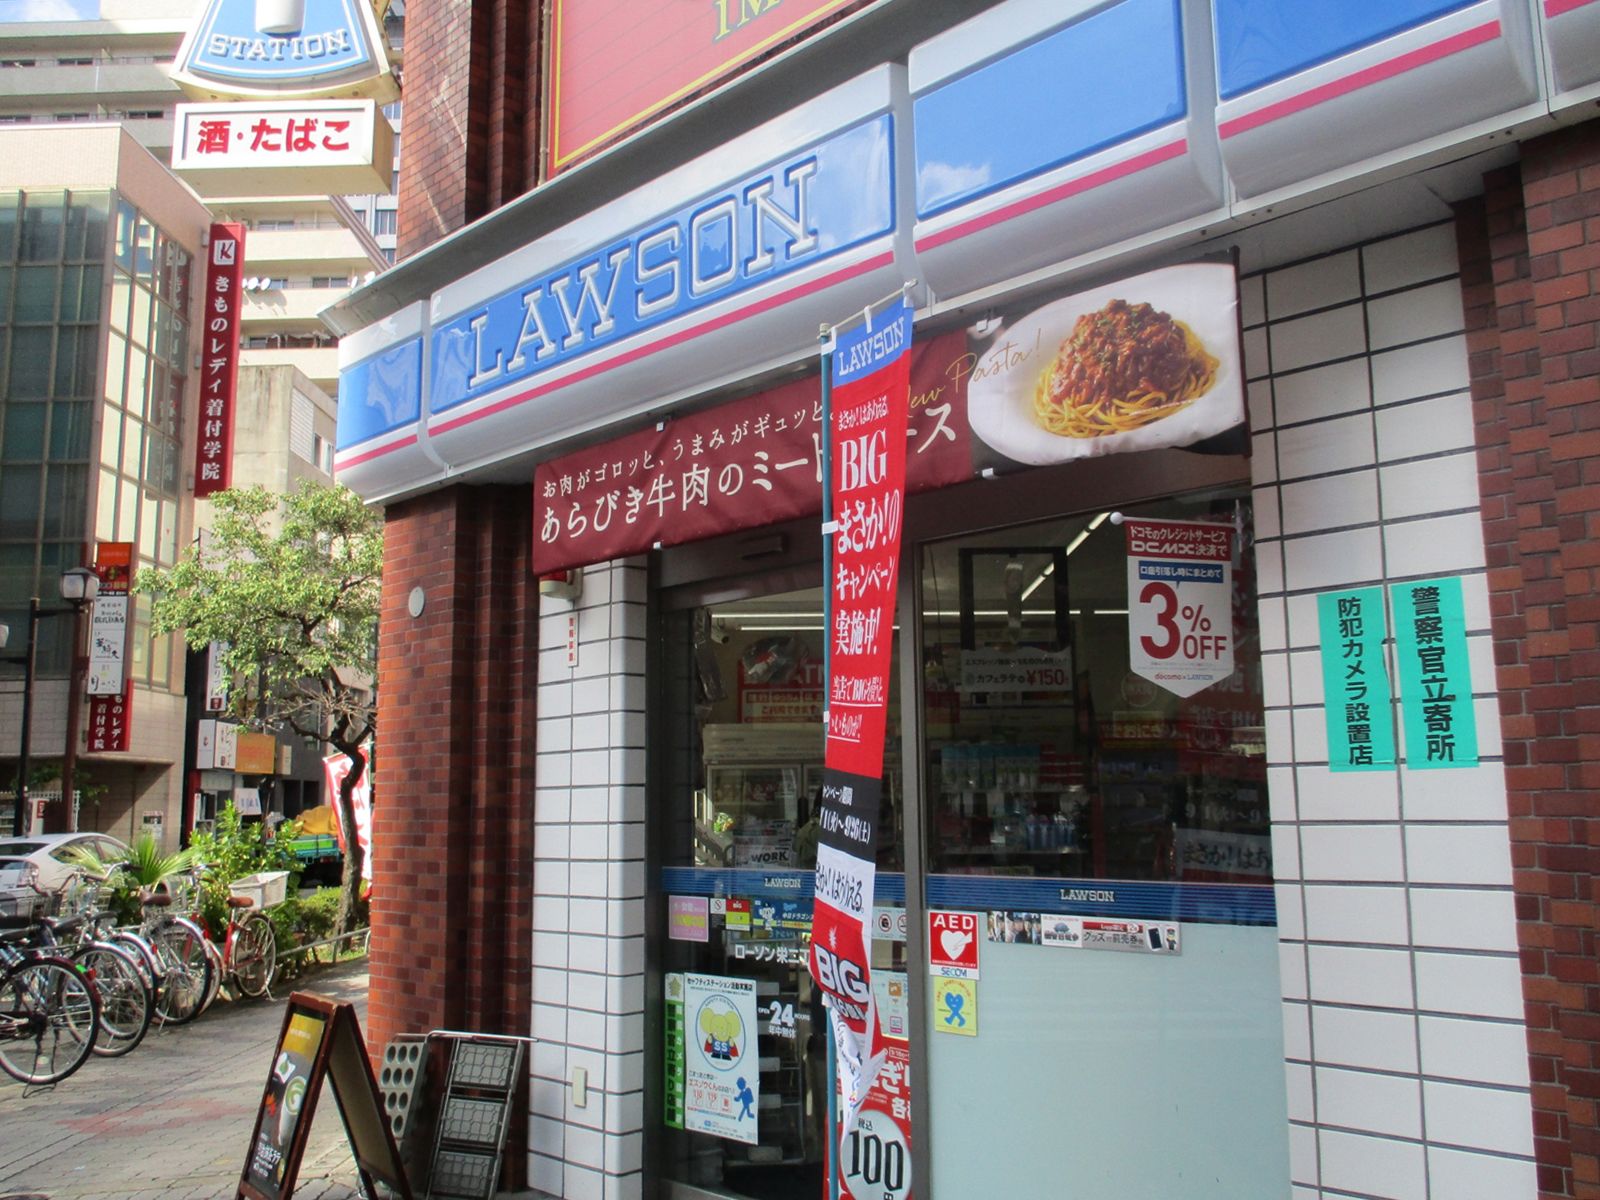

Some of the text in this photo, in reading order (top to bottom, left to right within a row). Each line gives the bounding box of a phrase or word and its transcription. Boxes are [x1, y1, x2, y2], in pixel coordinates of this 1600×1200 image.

[207, 28, 352, 62] STATION
[197, 118, 351, 154] 酒・たばこ
[468, 155, 821, 390] LAWSON
[839, 316, 905, 376] LAWSON
[946, 328, 1042, 393] Pasta!
[201, 275, 230, 481] きものレディ着付学院
[838, 429, 889, 493] BIG
[1130, 526, 1227, 543] ドコモのクレジットサービス
[835, 606, 881, 656] 実施中!
[1183, 634, 1228, 661] OFF
[1336, 597, 1374, 766] 防犯カメラ設置店
[1411, 585, 1456, 763] 警察官立寄所
[764, 877, 801, 888] LAWSON
[1060, 888, 1115, 903] LAWSON
[933, 914, 974, 930] AED
[814, 943, 869, 1004] BIG
[769, 1000, 795, 1028] 24
[714, 1041, 729, 1053] SS
[858, 1117, 874, 1131] 税込
[847, 1129, 904, 1192] 100
